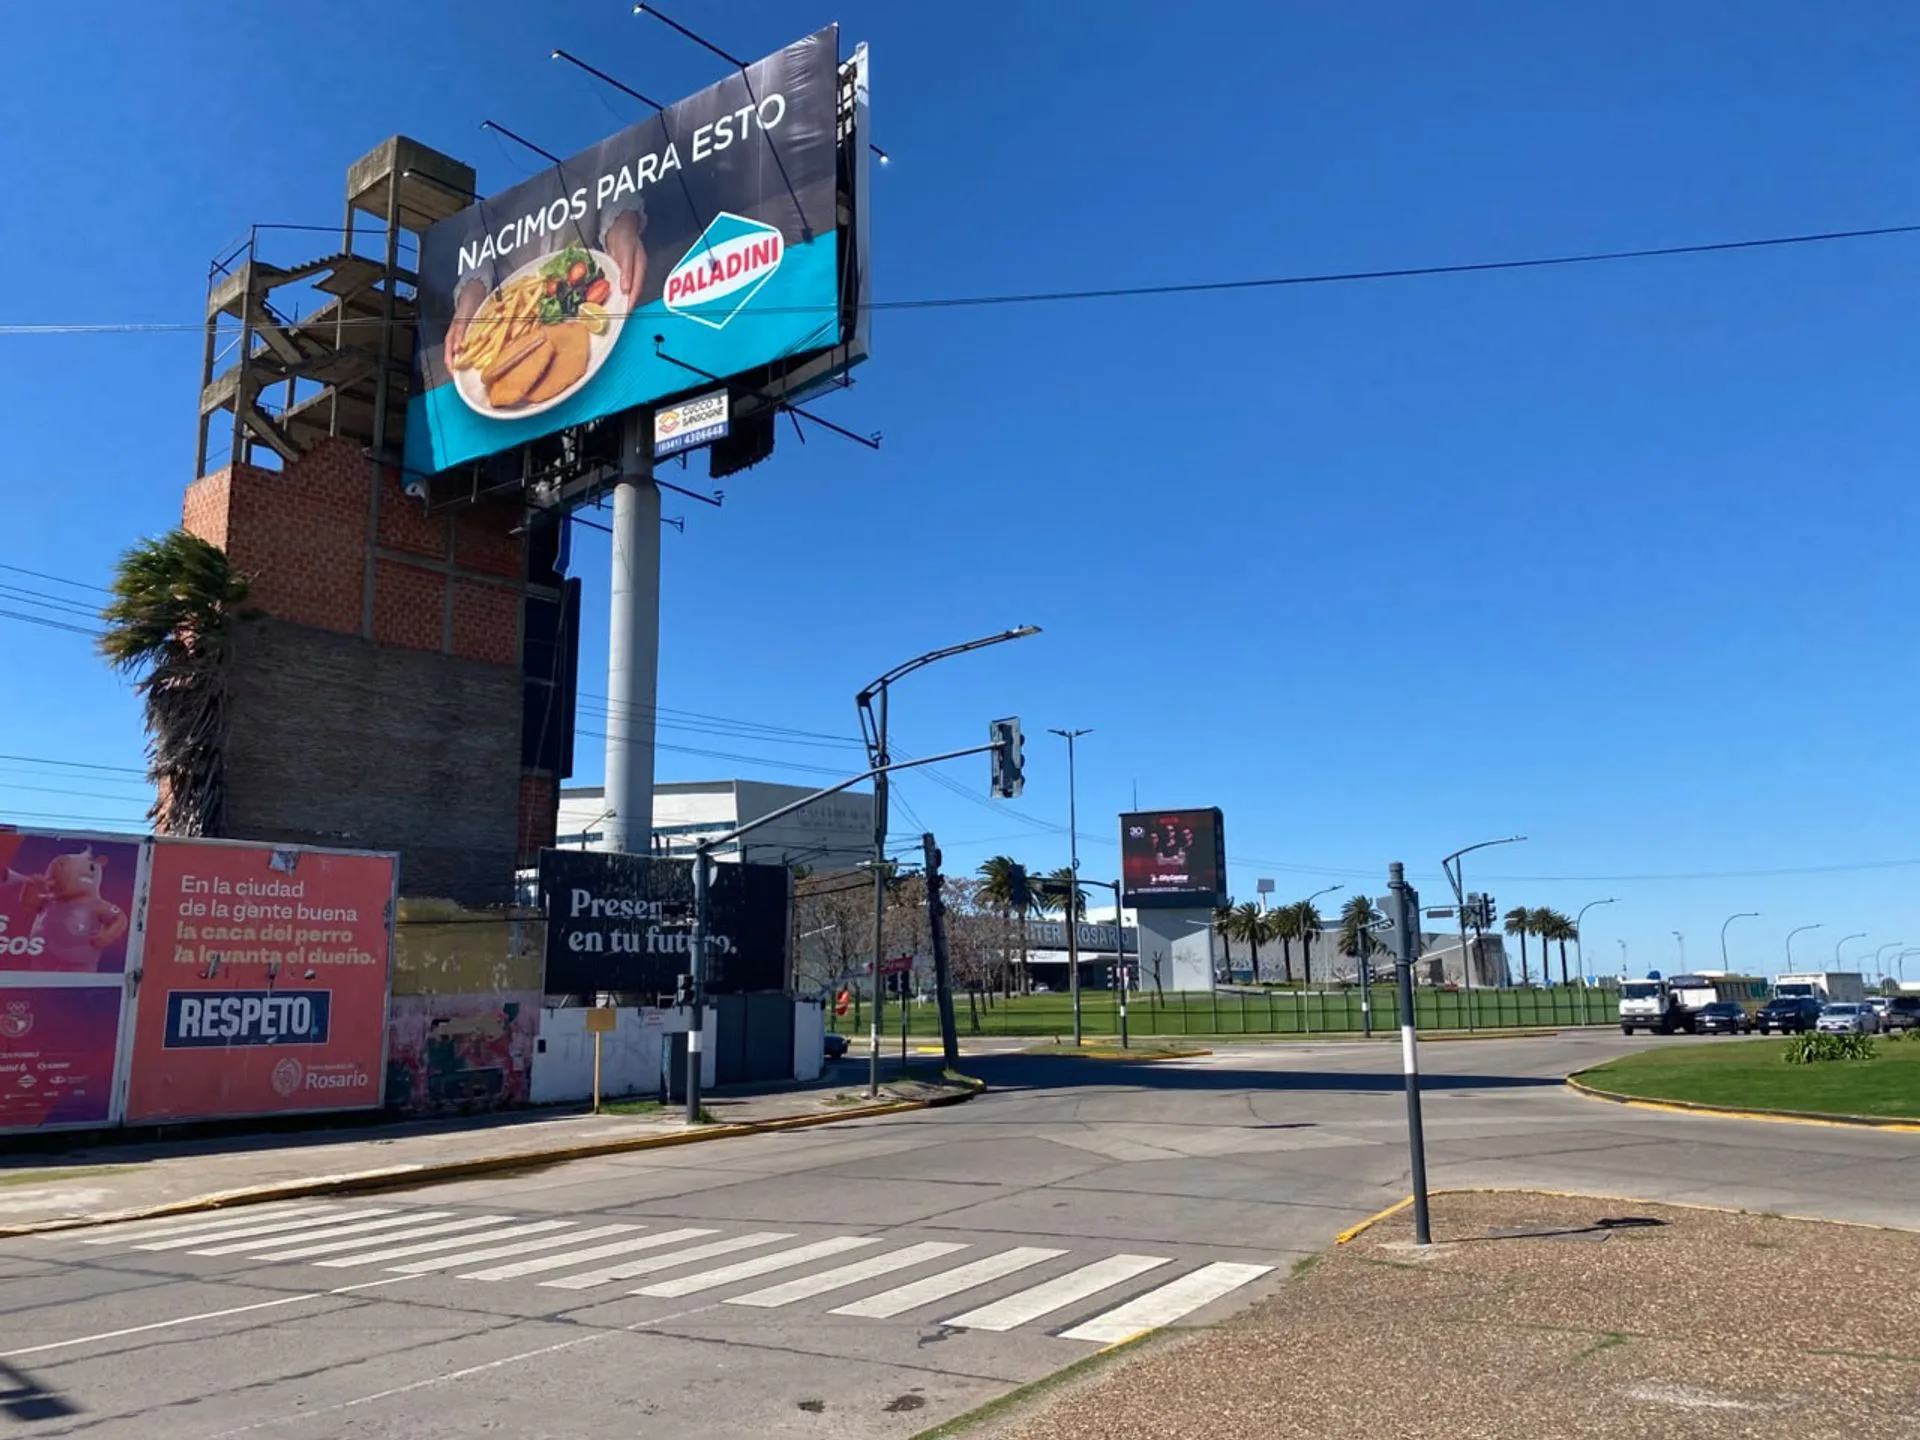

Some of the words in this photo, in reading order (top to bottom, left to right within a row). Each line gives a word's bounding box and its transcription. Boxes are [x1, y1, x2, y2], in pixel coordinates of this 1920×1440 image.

[457, 188, 588, 275] NACIMOS
[597, 142, 683, 210] PARA
[692, 94, 787, 162] ESTO
[668, 236, 778, 302] PALADINI
[181, 875, 208, 893] En
[214, 876, 231, 895] la
[235, 878, 304, 898] ciudad
[179, 898, 206, 917] de
[211, 899, 230, 917] la
[233, 903, 293, 922] gente
[297, 902, 358, 922] buena
[570, 888, 663, 920] Presen
[176, 920, 197, 940] la
[201, 926, 256, 941] caca
[260, 924, 292, 941] del
[295, 928, 353, 945] perro
[568, 930, 604, 952] en
[610, 928, 641, 953] tu
[174, 944, 194, 963] la
[199, 944, 283, 964] levanta
[286, 946, 304, 964] el
[308, 947, 376, 965] dueño.
[305, 1070, 369, 1089] Rosario
